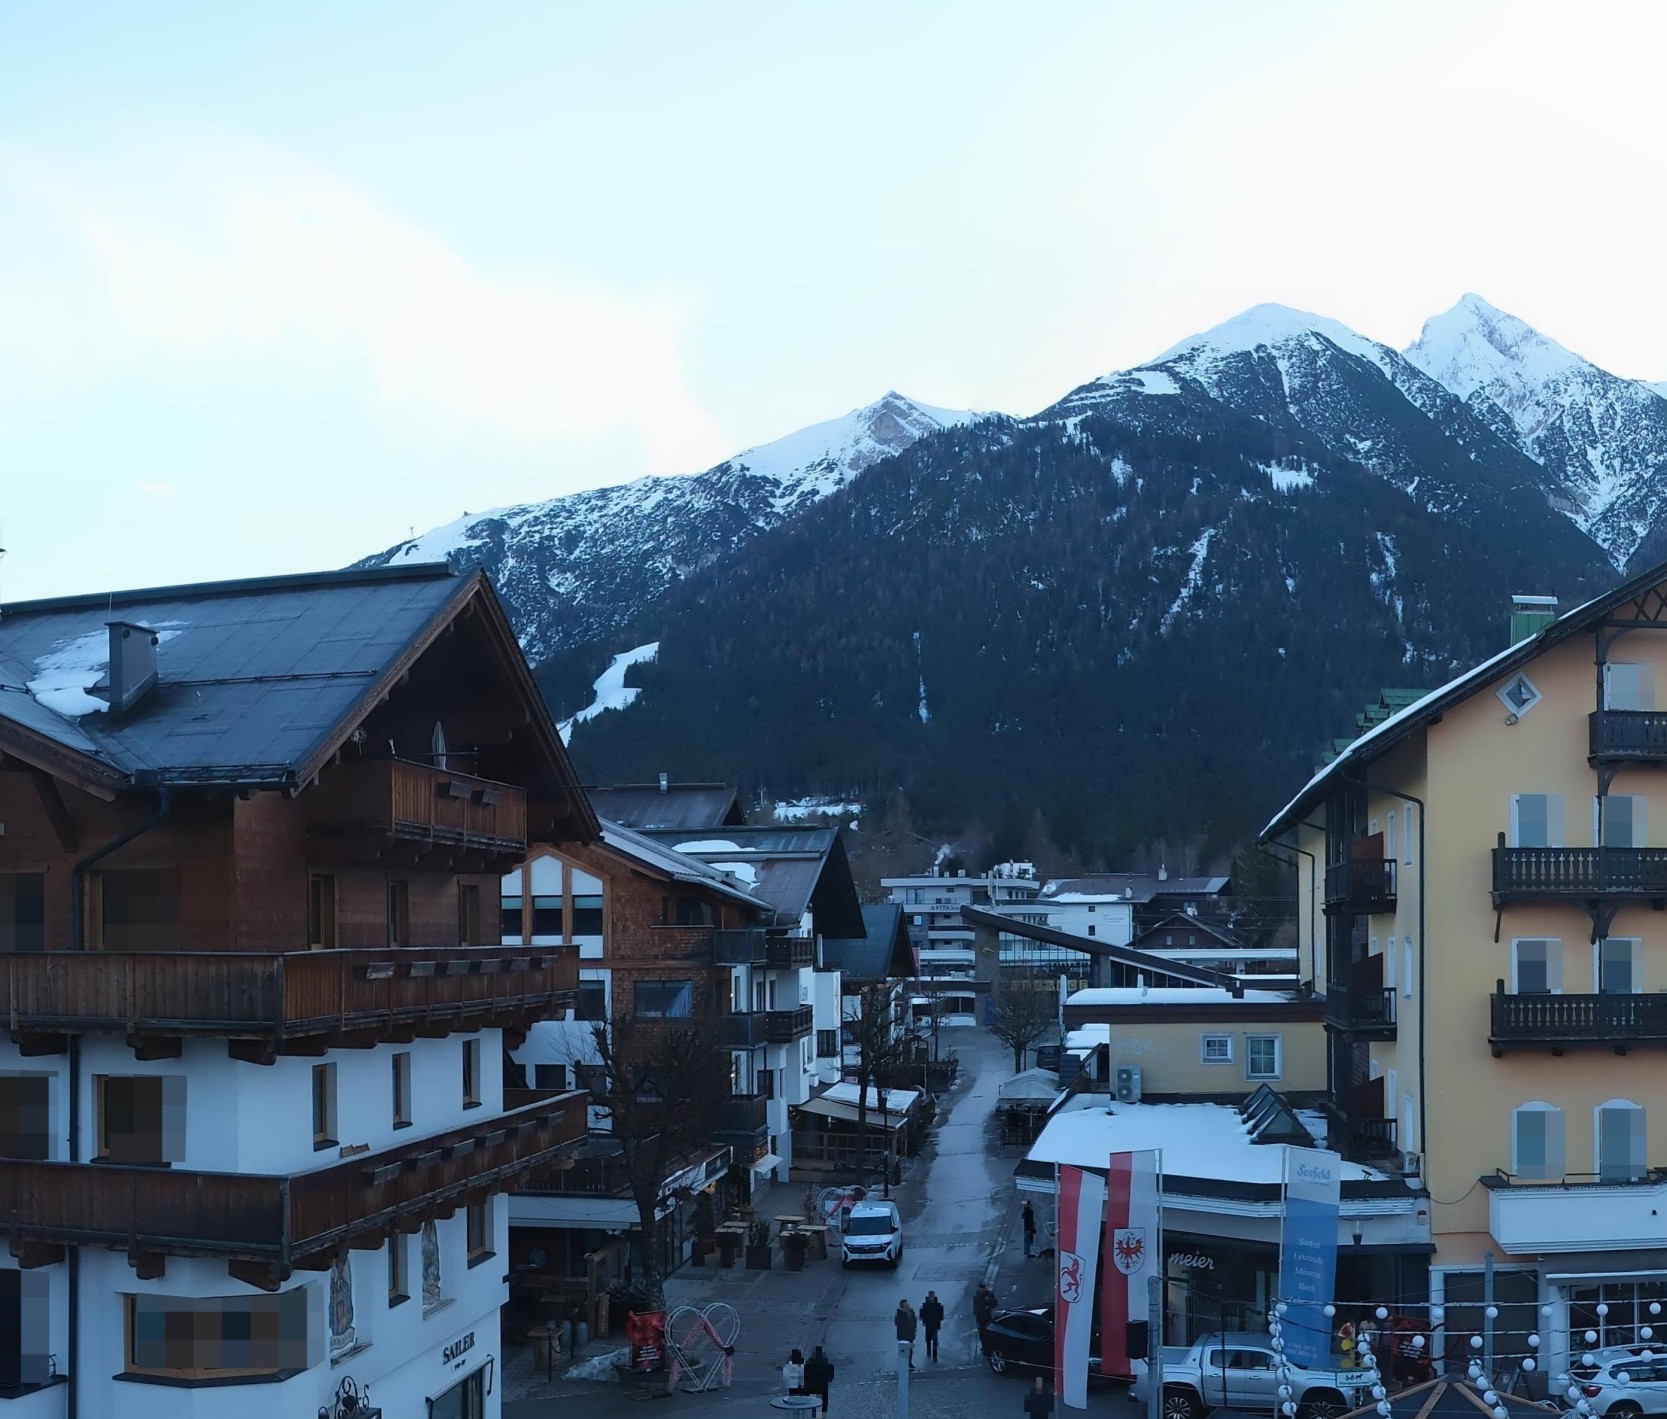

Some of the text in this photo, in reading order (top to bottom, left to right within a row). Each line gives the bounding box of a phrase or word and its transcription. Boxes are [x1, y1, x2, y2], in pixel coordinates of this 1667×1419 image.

[1297, 1163, 1332, 1181] Seefeld
[1168, 1250, 1215, 1271] meier
[442, 1331, 476, 1366] SAILER
